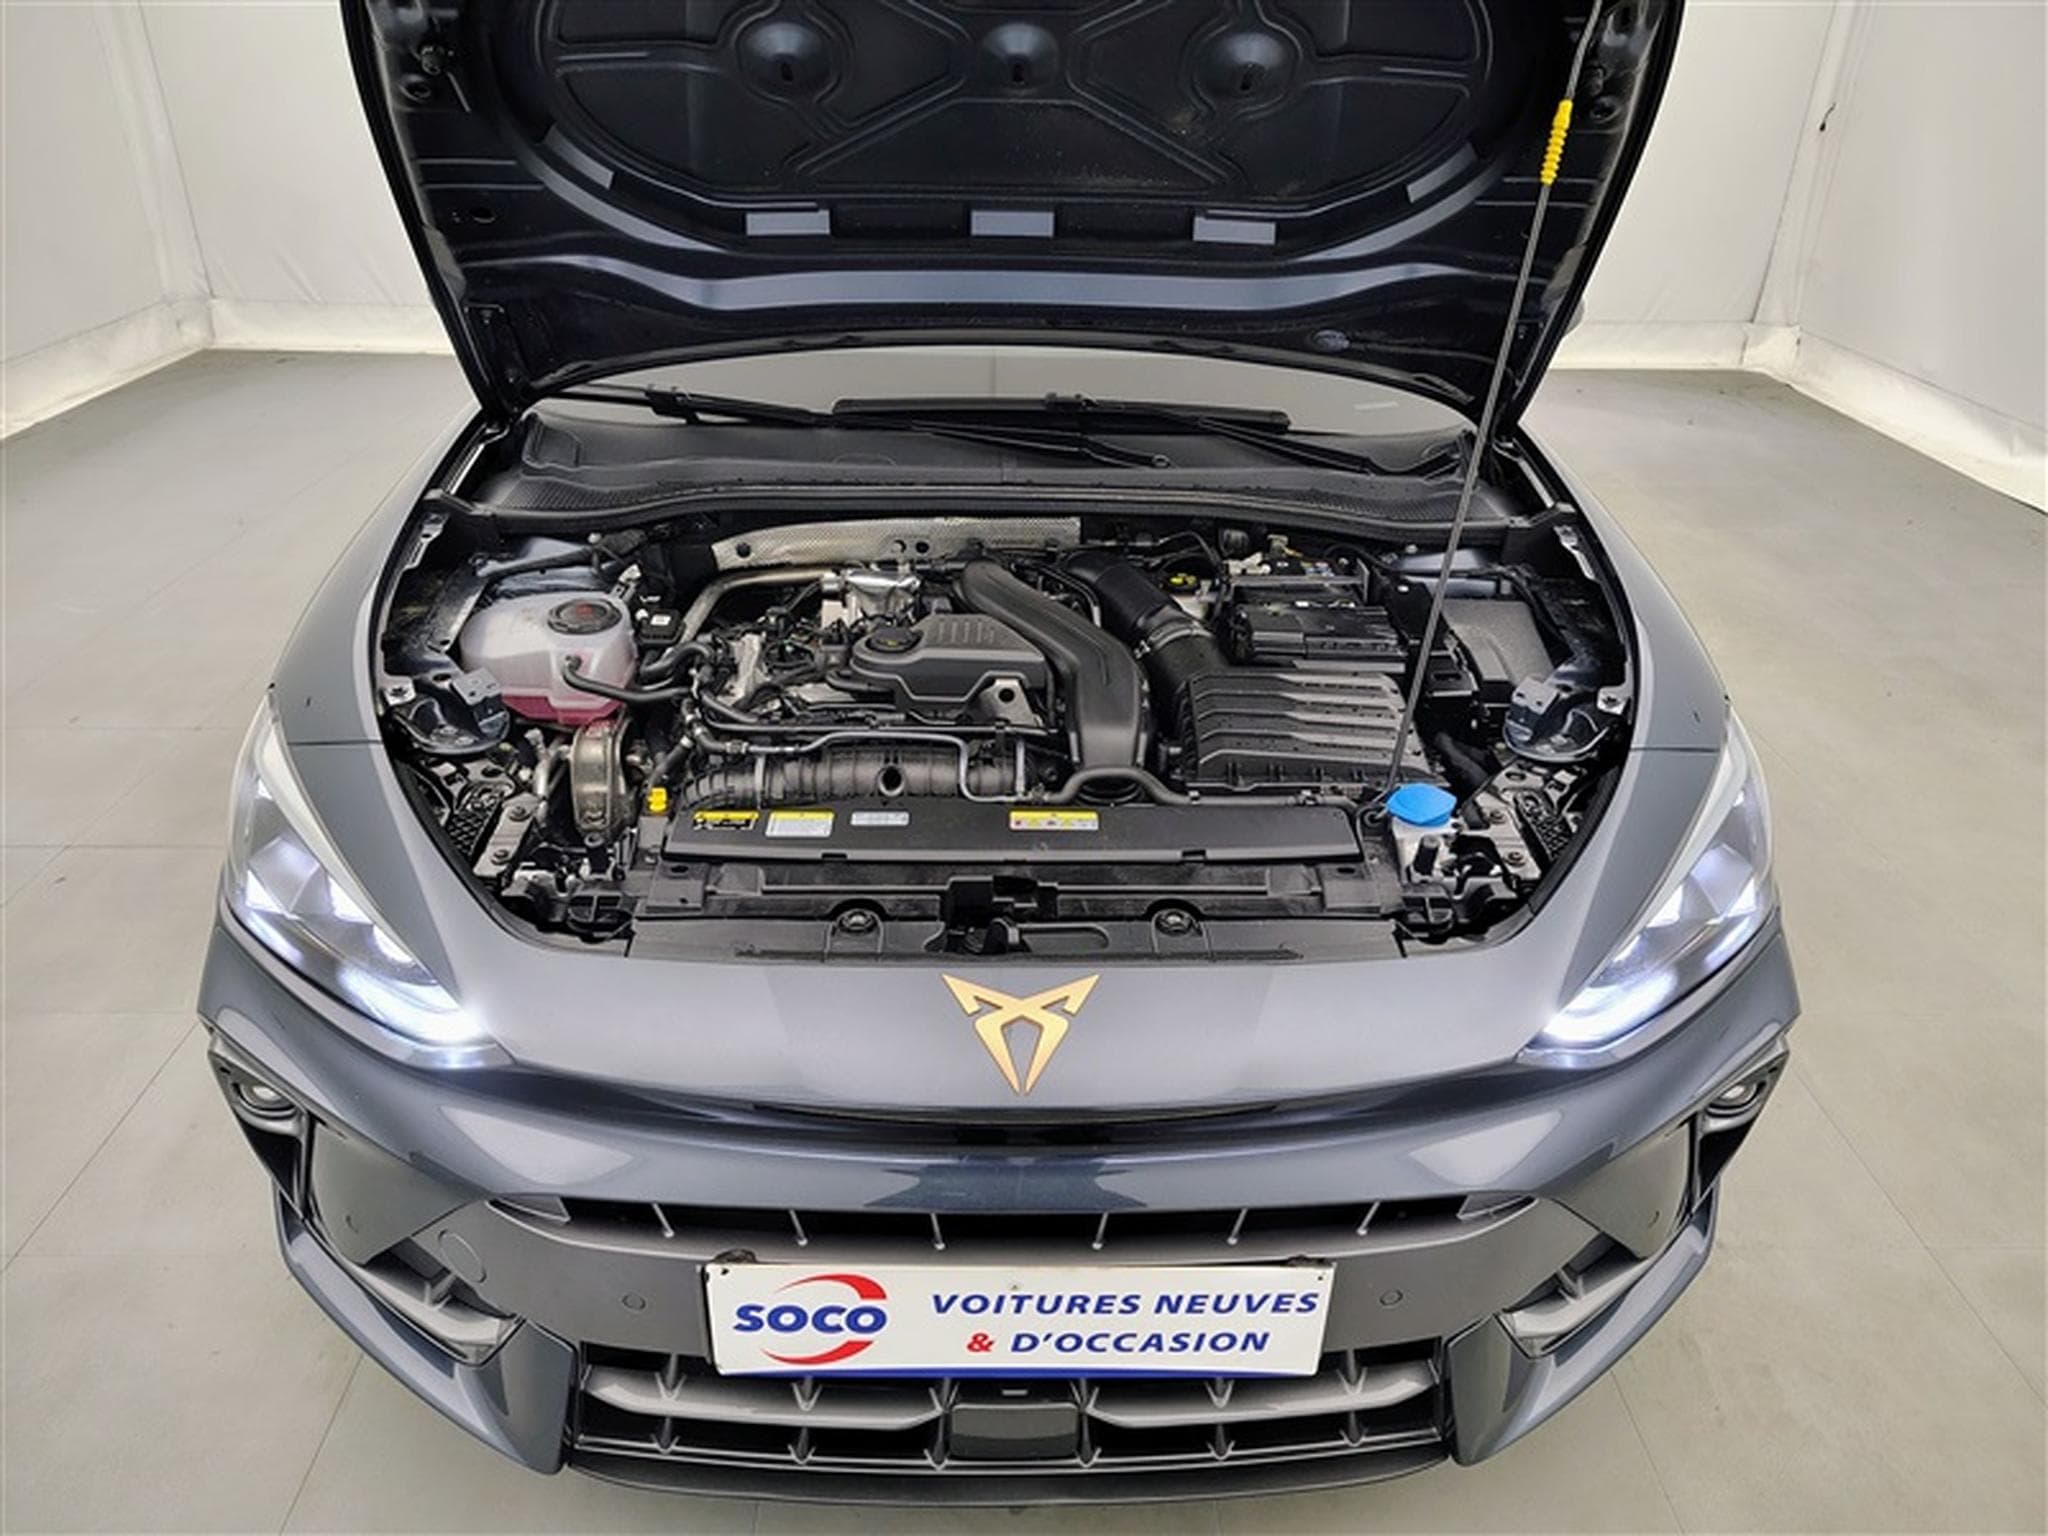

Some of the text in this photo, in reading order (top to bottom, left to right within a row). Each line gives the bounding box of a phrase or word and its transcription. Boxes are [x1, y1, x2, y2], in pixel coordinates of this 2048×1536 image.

[932, 1292, 1319, 1315] VOITURES NEUVES
[733, 1303, 888, 1334] SOCO
[967, 1332, 1270, 1353] & D'OCCASION
